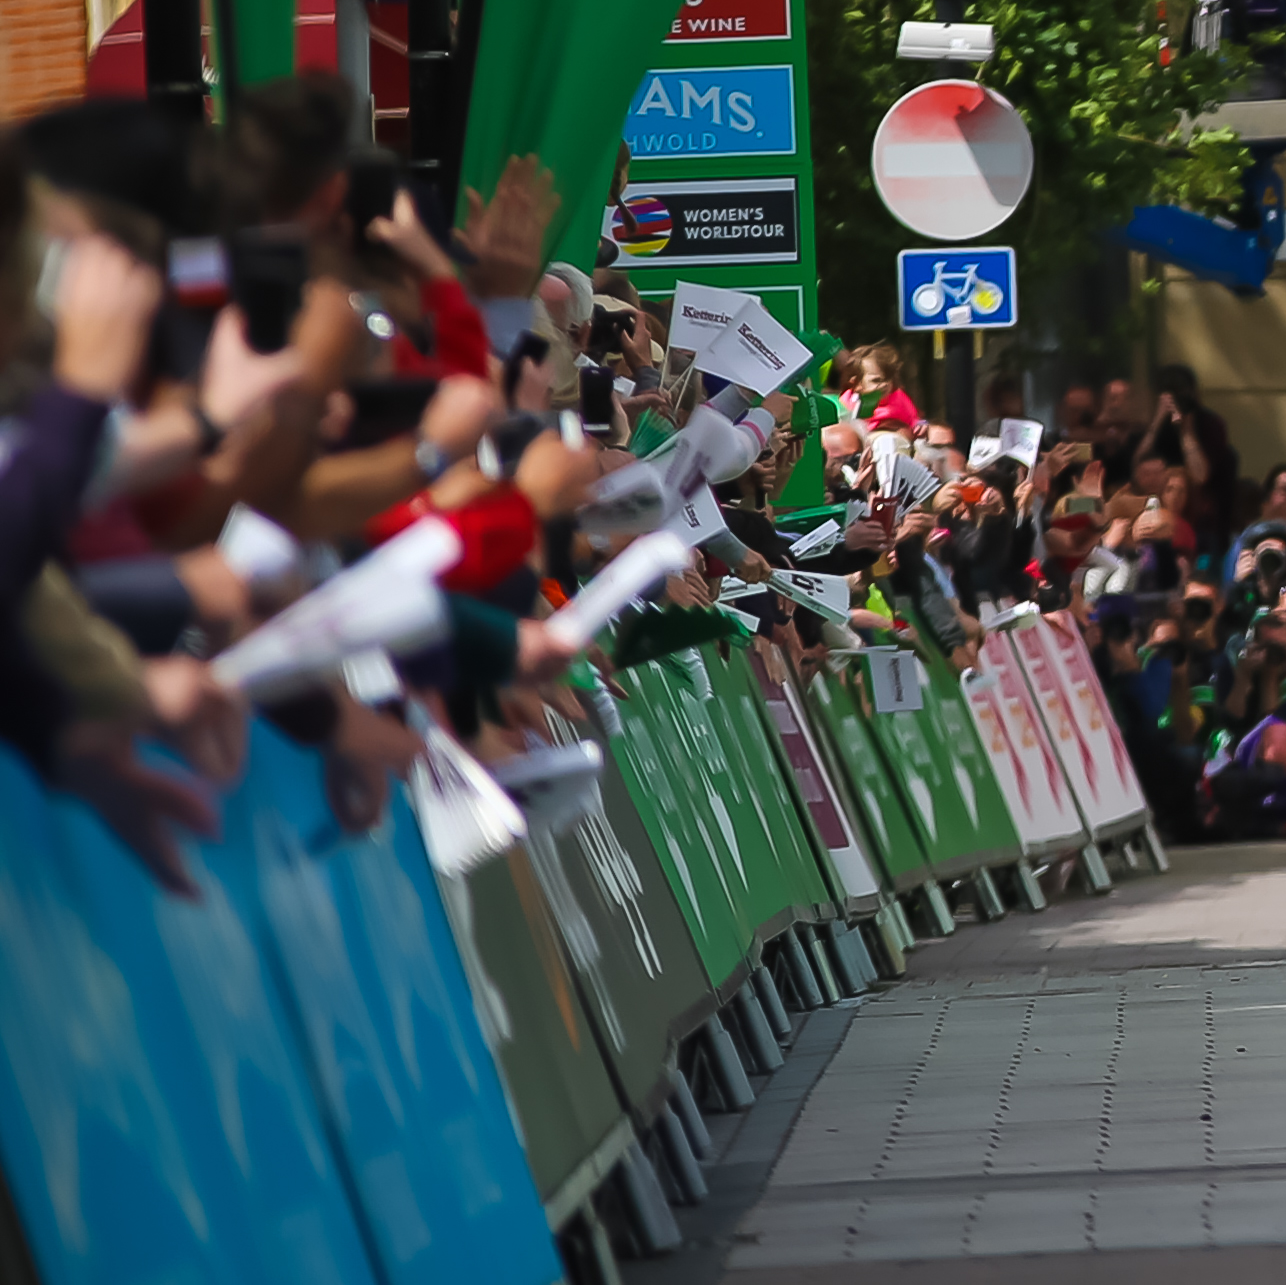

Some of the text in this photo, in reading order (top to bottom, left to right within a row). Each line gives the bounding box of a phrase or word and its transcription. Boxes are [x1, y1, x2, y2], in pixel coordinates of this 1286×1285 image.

[687, 17, 746, 33] WINE
[684, 207, 764, 223] WOMEN'S
[684, 223, 785, 240] WORLDTOUR
